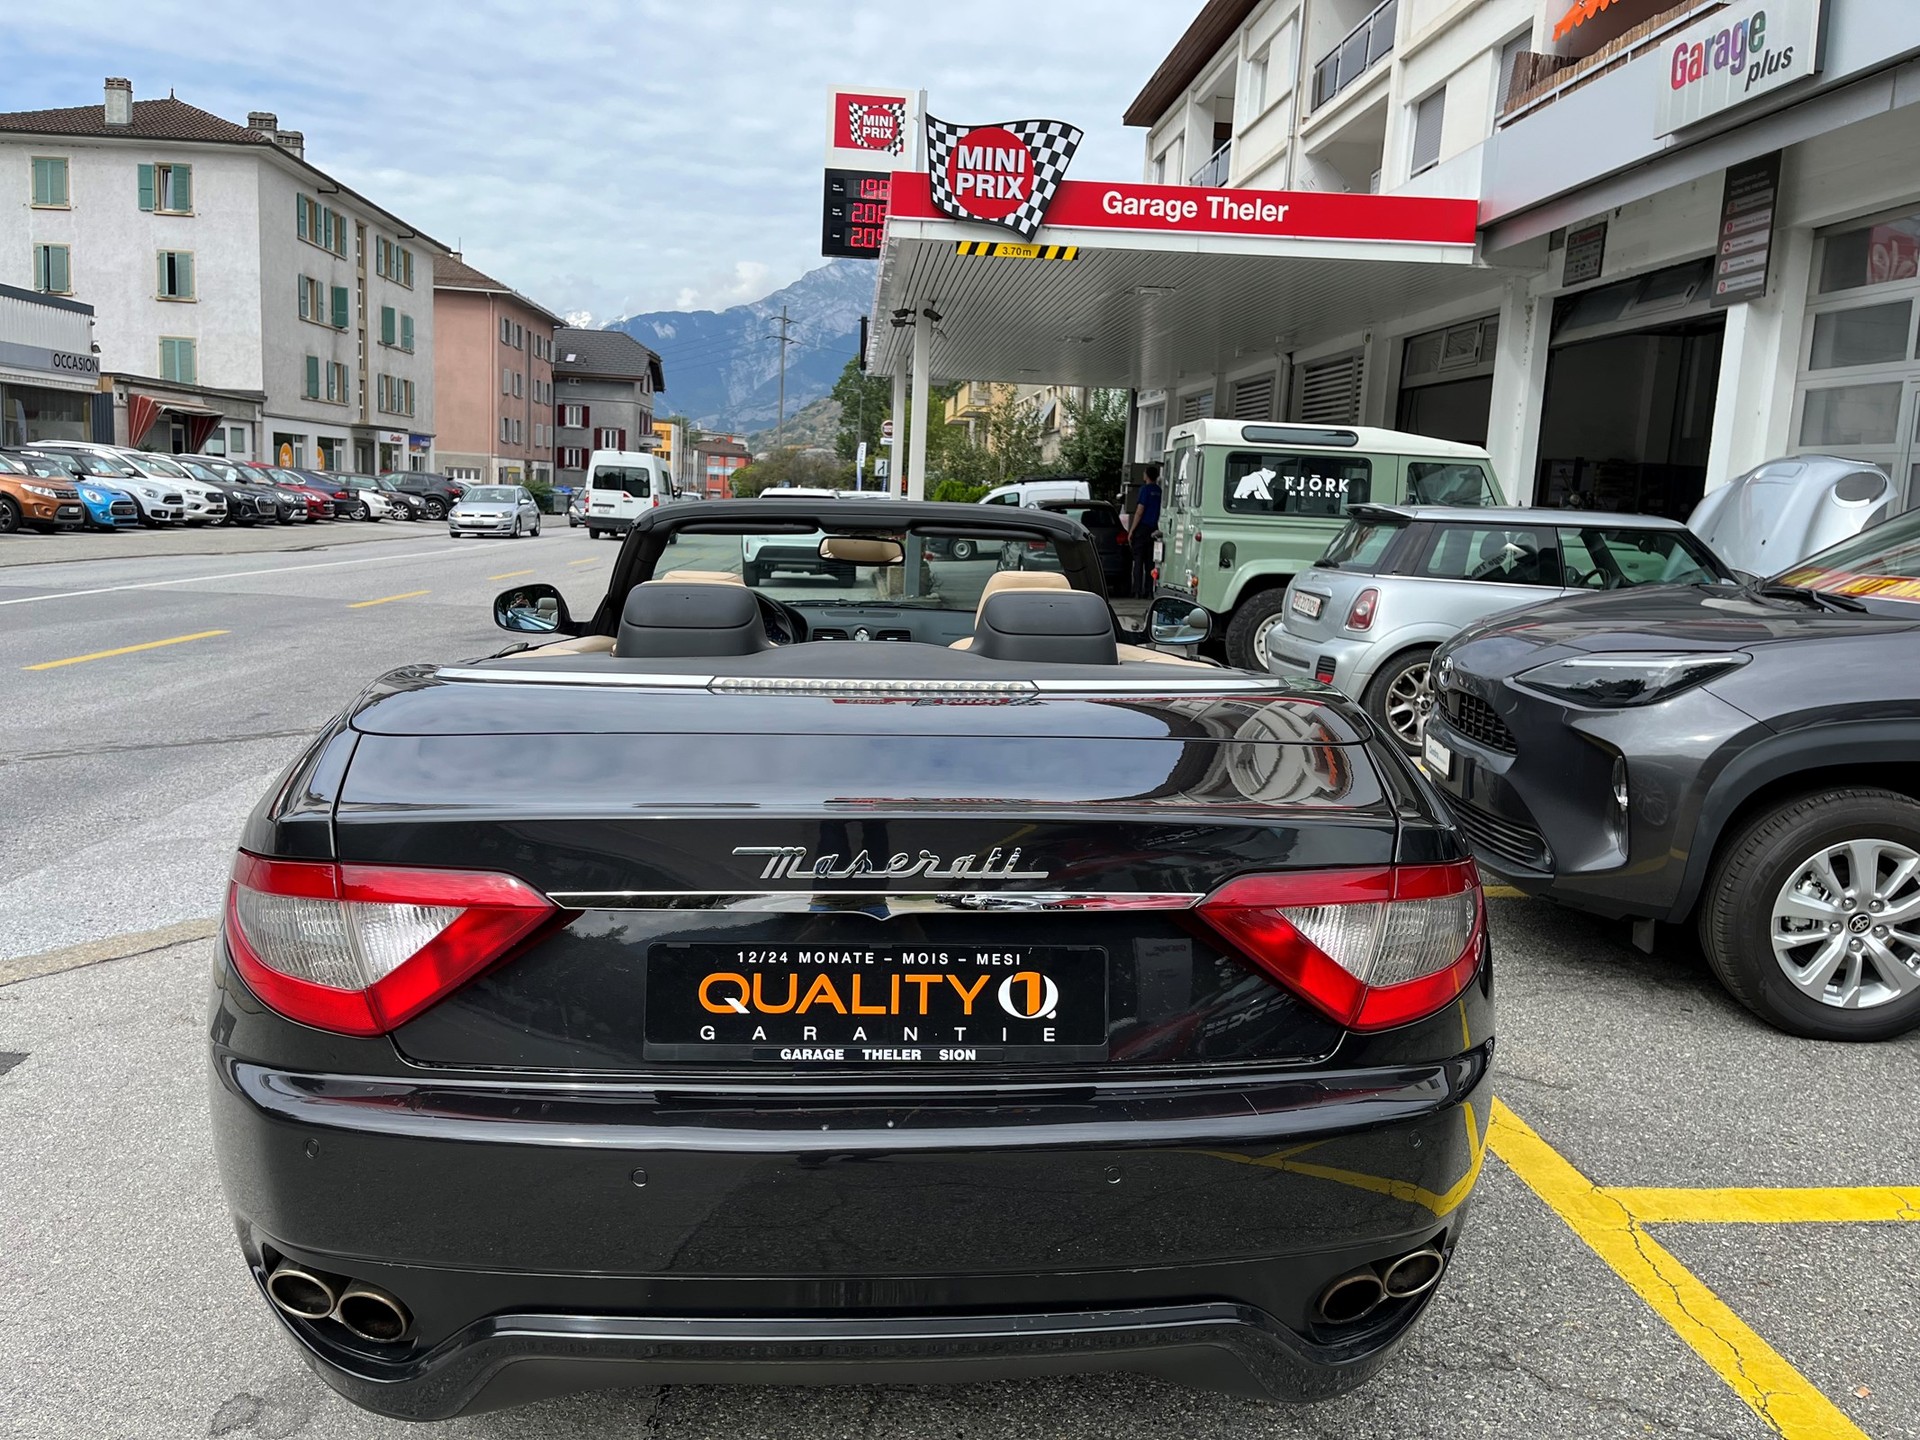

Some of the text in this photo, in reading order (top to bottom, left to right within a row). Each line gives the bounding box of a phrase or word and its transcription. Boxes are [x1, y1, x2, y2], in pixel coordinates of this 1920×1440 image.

[1671, 10, 1766, 90] Garage
[1744, 46, 1794, 92] plus
[862, 127, 893, 140] PRIX
[863, 114, 894, 129] MINI
[957, 145, 1026, 174] MINI
[955, 172, 1025, 200] PRIX
[1102, 190, 1289, 223] Garage Theler
[53, 353, 99, 373] OCCASION
[1289, 490, 1340, 498] MERINO
[731, 846, 1050, 881] Maserati
[737, 951, 789, 965] 12/24
[799, 951, 875, 965] MONATE
[902, 952, 949, 965] MOIS
[976, 953, 1021, 966] MESI
[698, 971, 991, 1015] QUALITY
[700, 1025, 1056, 1042] GARANTIE
[780, 1048, 976, 1061] GARAGE THELER SION
